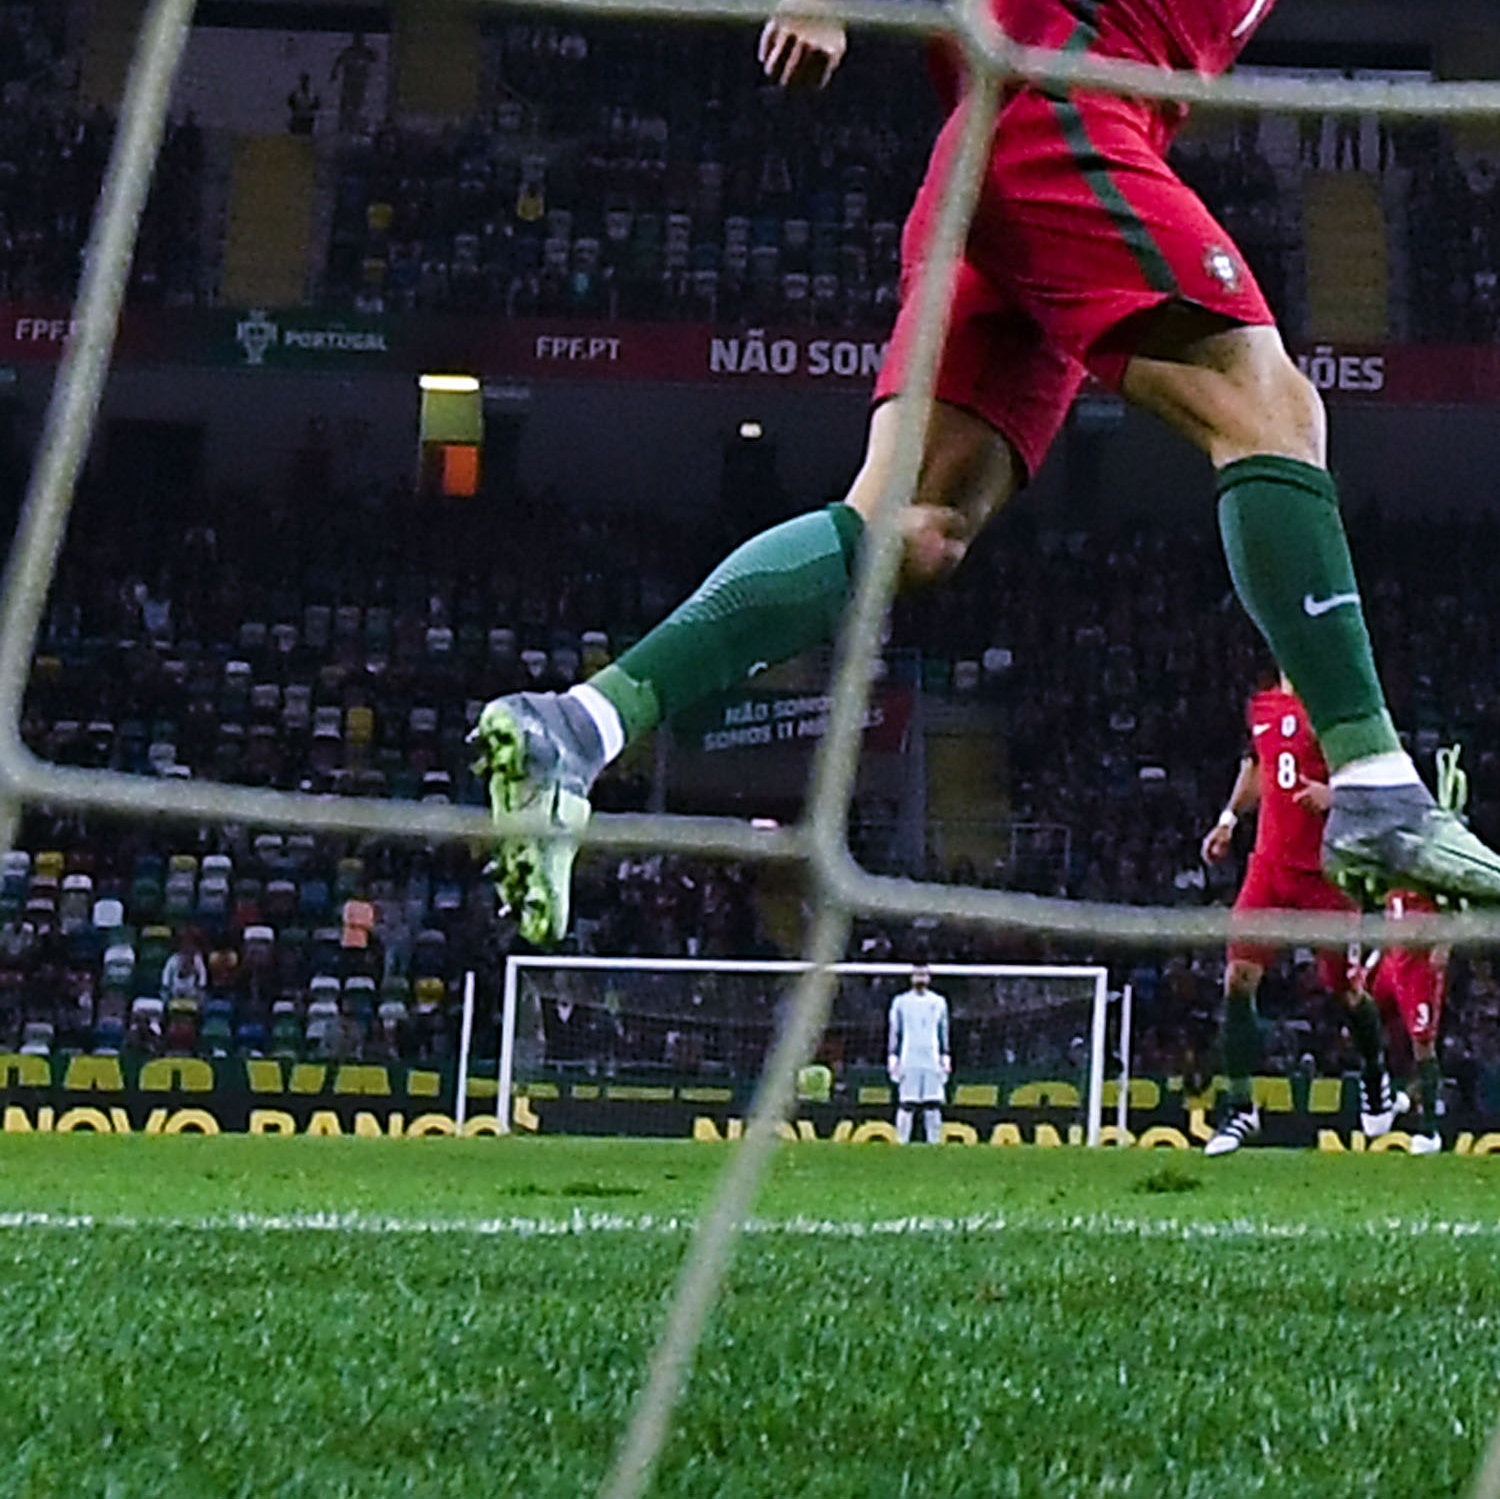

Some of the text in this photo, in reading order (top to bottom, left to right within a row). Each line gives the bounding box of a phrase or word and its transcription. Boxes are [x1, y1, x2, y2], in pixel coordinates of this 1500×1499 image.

[14, 317, 80, 342] FPF.
[284, 330, 389, 353] PORTUGAL
[534, 335, 622, 361] FPF.PT
[709, 329, 798, 375] NÃO
[1278, 752, 1296, 790] 8
